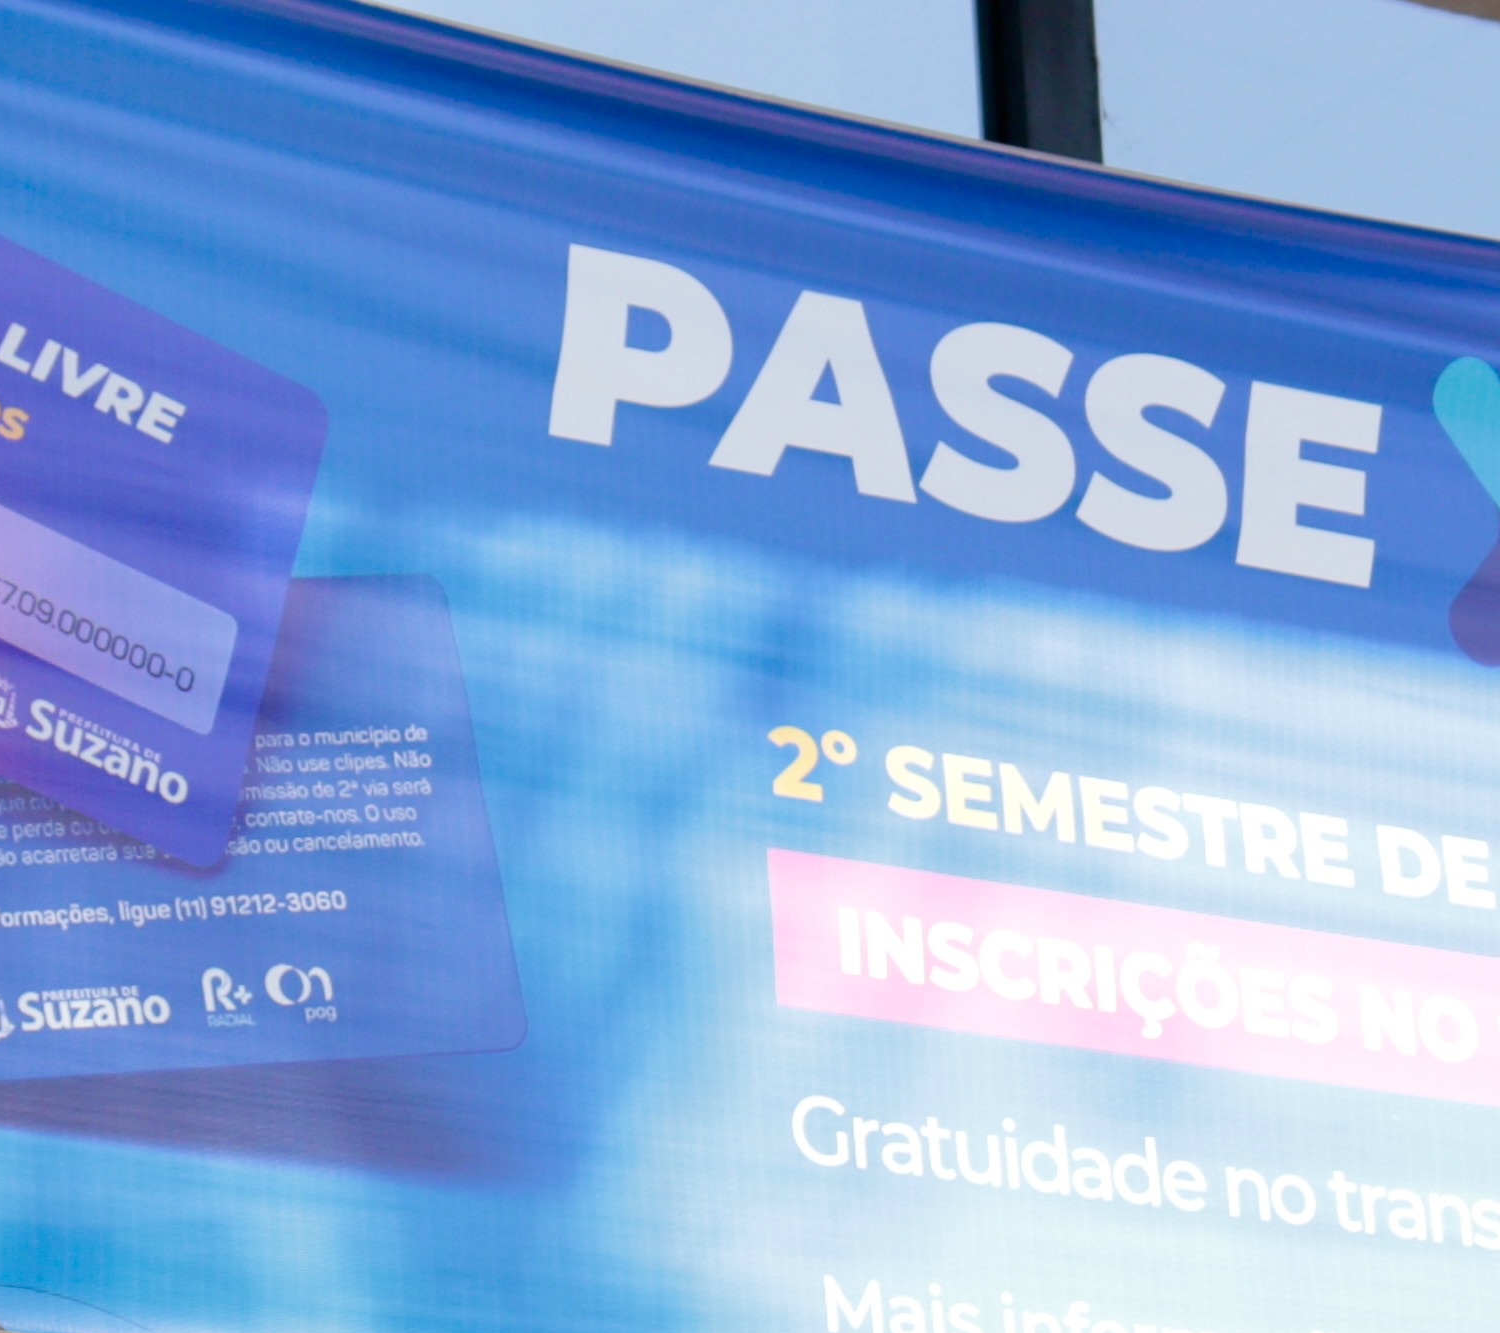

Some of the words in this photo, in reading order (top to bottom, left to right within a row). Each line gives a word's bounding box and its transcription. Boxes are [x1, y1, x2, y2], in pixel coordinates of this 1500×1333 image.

[548, 243, 1383, 588] PASSE
[59, 708, 139, 754] PREFEITURA
[143, 747, 162, 763] DE
[255, 733, 294, 750] para
[299, 734, 310, 745] o
[314, 726, 400, 748] município
[404, 724, 428, 742] de
[25, 699, 188, 804] Suzano
[256, 756, 292, 773] Não
[297, 758, 330, 773] use
[334, 752, 389, 775] clipes.
[393, 749, 432, 768] Não
[312, 780, 335, 798] de
[362, 780, 388, 796] via
[393, 776, 432, 796] será
[245, 807, 362, 829] contate-nos.
[364, 803, 380, 822] O
[383, 805, 417, 822] uso
[885, 744, 1356, 890] SEMESTRE
[1376, 823, 1497, 910] DE
[12, 819, 65, 841] perda
[265, 837, 289, 853] ou
[292, 830, 425, 852] cancelamento.
[21, 843, 118, 865] acarretará
[118, 898, 172, 927] ligue
[175, 896, 208, 921] (11)
[211, 890, 347, 917] 91212-3060
[41, 986, 118, 1001] PREFEITURA
[120, 985, 139, 997] DE
[837, 905, 1339, 1046] INSCRIÇÕES
[1358, 983, 1479, 1064] NO
[18, 991, 171, 1031] Suzano
[207, 1012, 257, 1028] RADIAL
[791, 1095, 1208, 1212] Gratuidade
[1225, 1164, 1317, 1226] no
